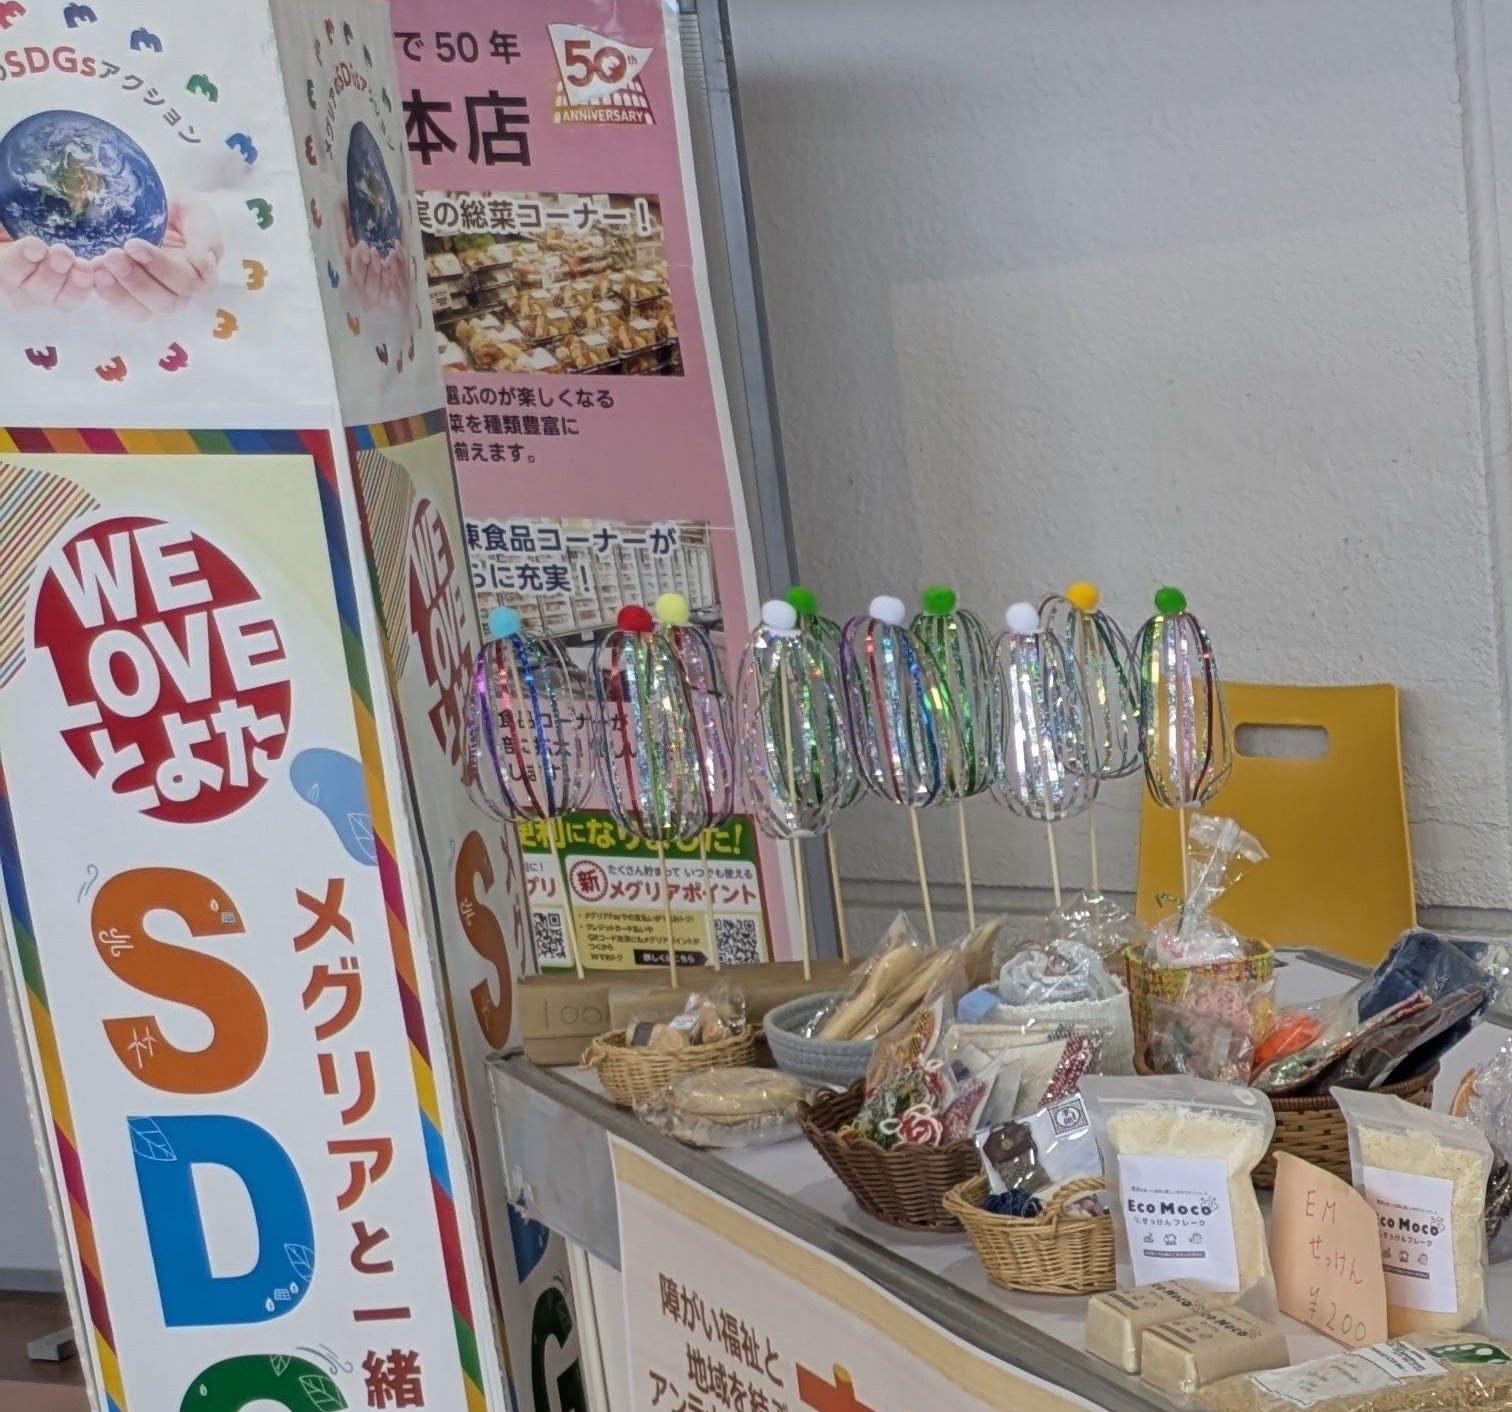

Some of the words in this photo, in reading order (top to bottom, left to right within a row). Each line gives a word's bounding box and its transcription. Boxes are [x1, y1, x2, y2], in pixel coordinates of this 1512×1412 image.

[403, 89, 532, 167] 本店
[562, 108, 645, 124] ANNIVERSARY
[49, 520, 213, 629] WE
[35, 602, 291, 735] LOVE
[90, 700, 286, 808] とよた
[577, 869, 600, 893] 新
[1128, 1199, 1155, 1213] Eco
[1160, 1202, 1212, 1216] Moco
[1305, 1190, 1336, 1223] EM
[1377, 1213, 1395, 1228] co
[1399, 1217, 1439, 1236] Moco
[1309, 1236, 1362, 1284] せっけん
[659, 1272, 784, 1388] 障がい福祉と
[1308, 1286, 1366, 1341] ¥200
